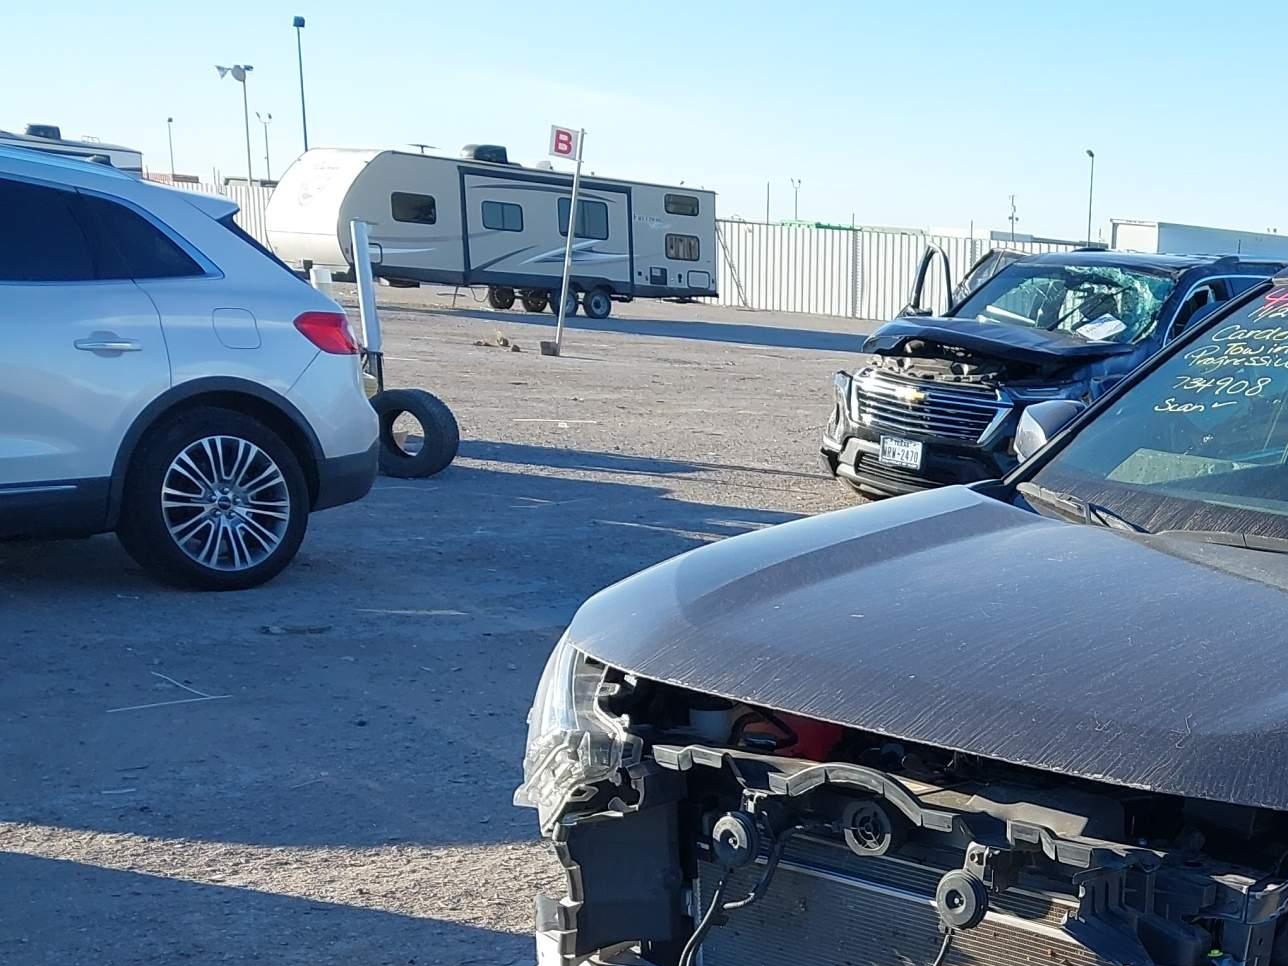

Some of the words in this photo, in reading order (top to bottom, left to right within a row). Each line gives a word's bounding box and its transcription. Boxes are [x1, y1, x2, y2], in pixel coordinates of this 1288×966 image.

[554, 129, 572, 154] B
[1224, 342, 1264, 355] Tow
[1172, 376, 1272, 396] 734908
[1154, 398, 1205, 412] Scan
